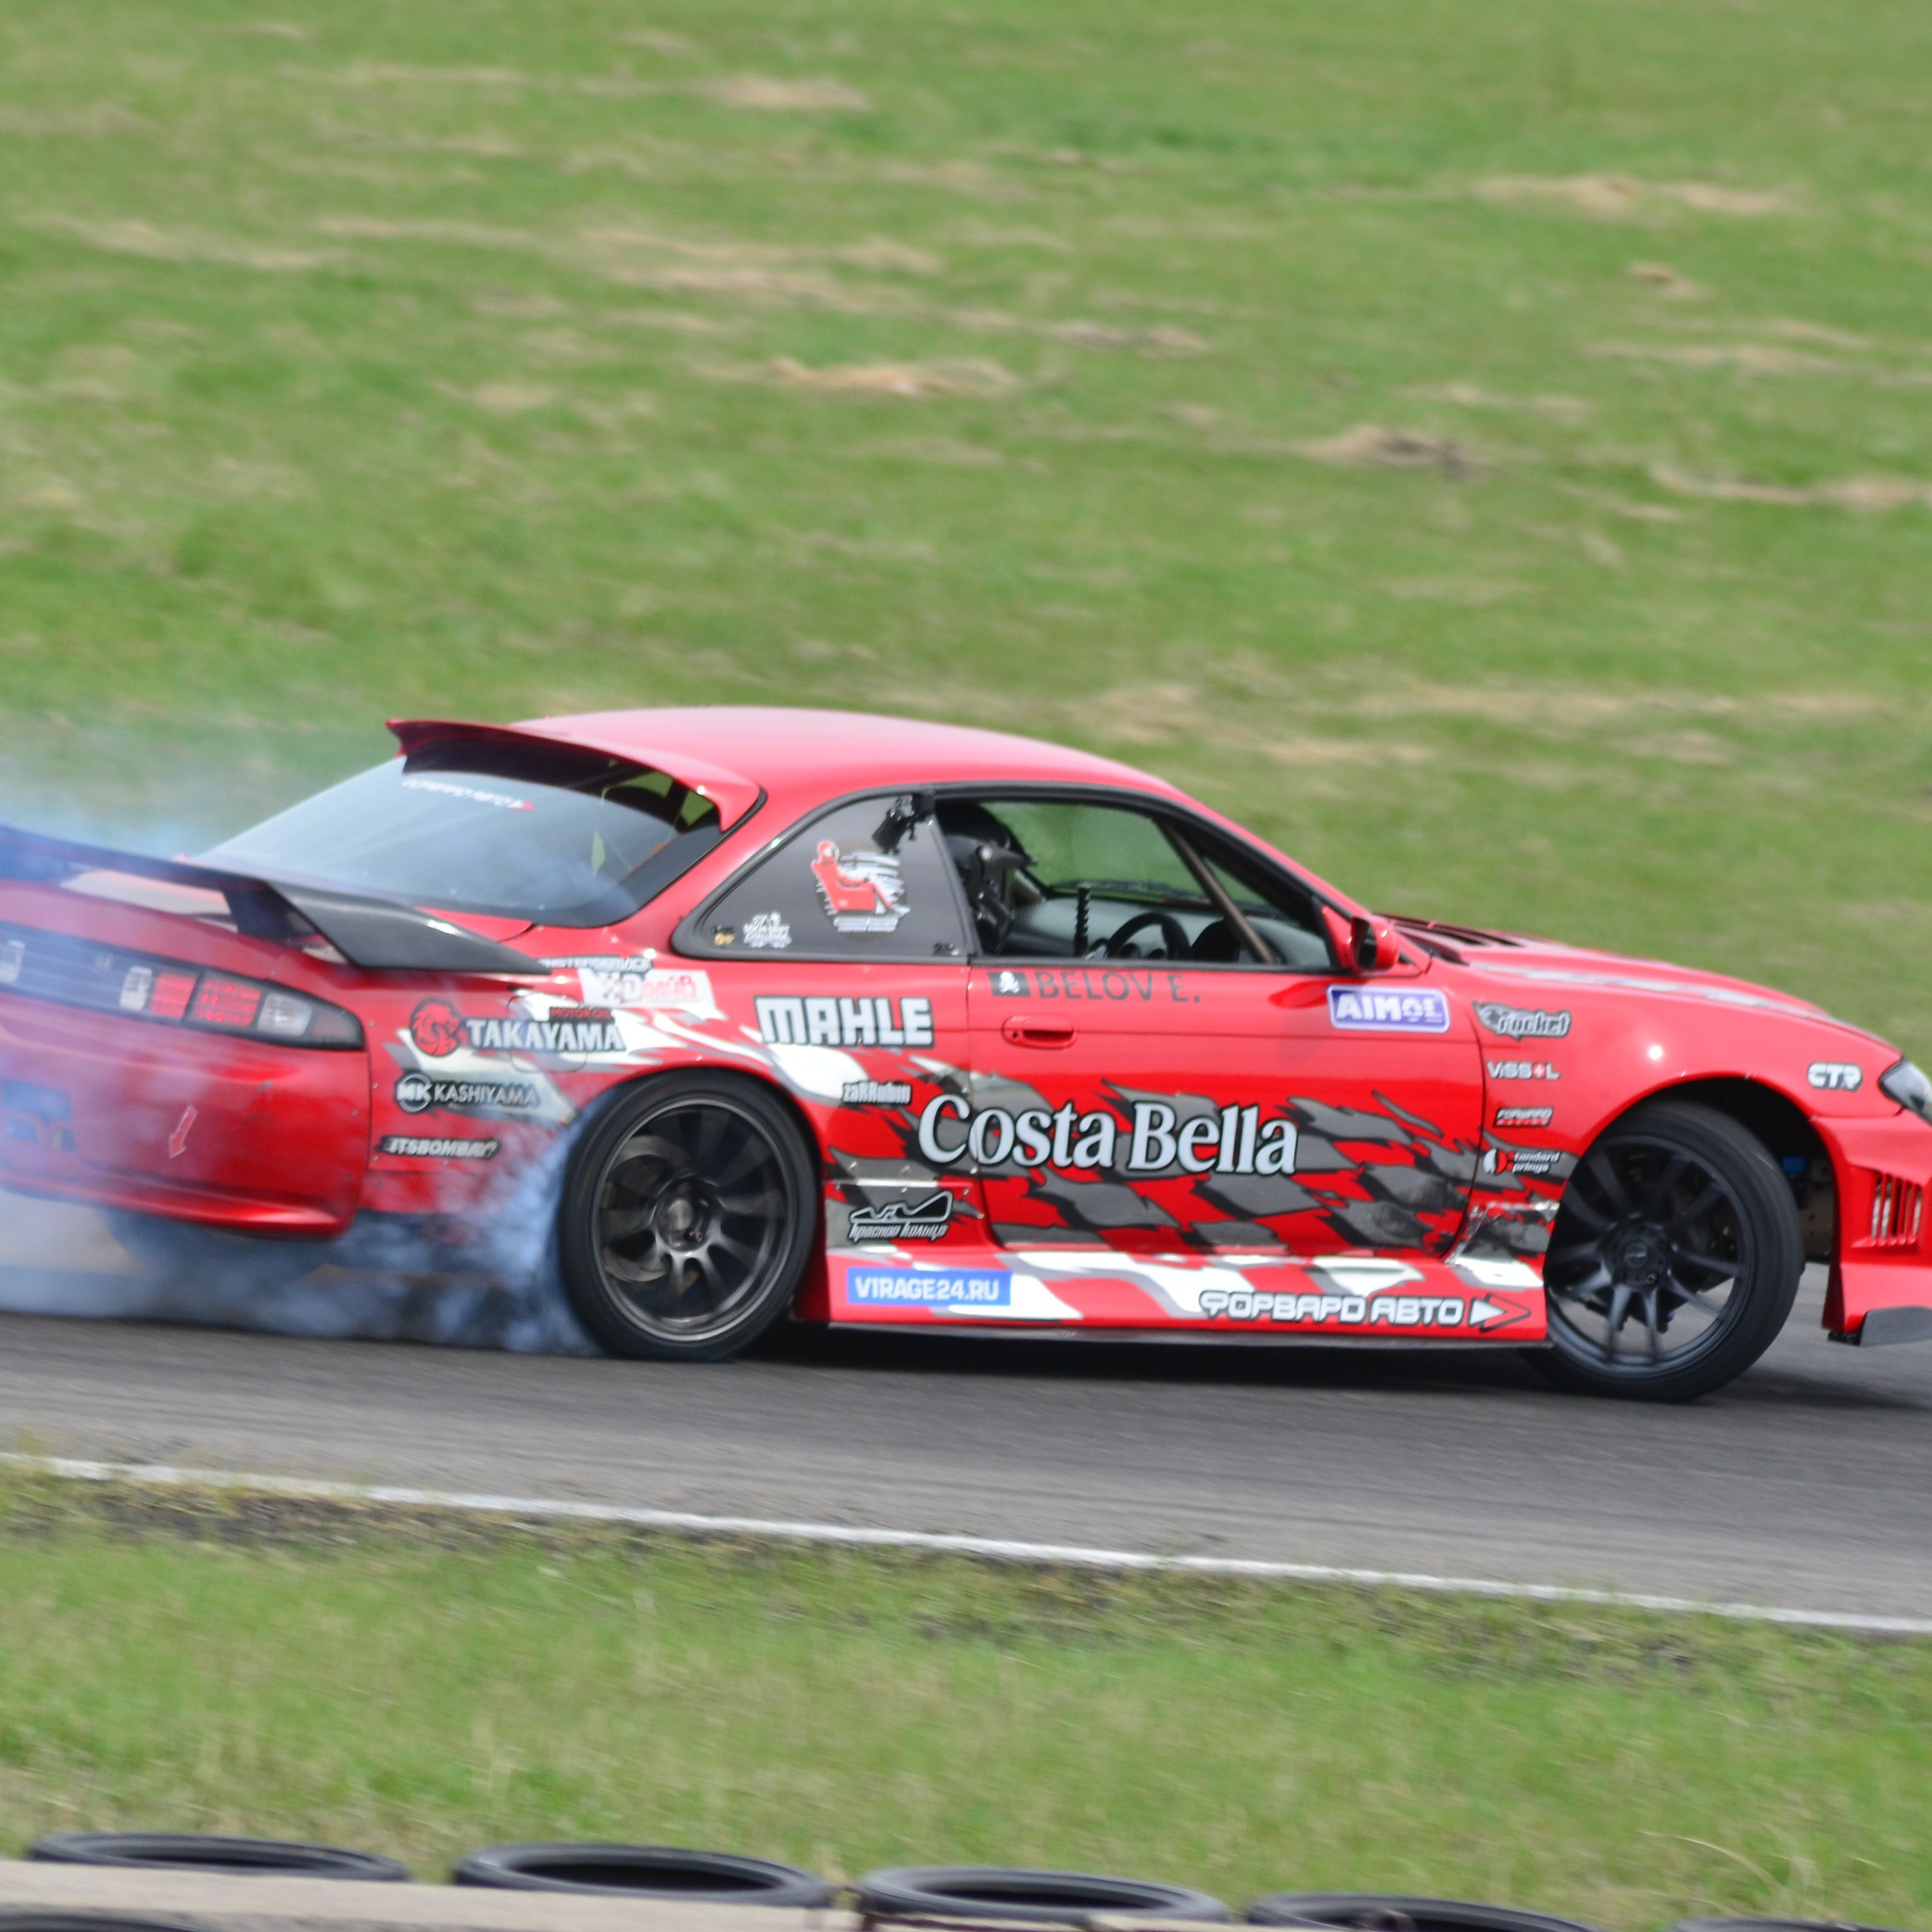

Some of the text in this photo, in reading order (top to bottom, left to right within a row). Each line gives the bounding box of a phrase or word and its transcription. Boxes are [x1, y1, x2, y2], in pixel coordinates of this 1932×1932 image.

[1033, 971, 1201, 1003] BELOV E.
[755, 995, 934, 1048] MAHLE
[1335, 992, 1443, 1023] AIMOL
[465, 1019, 626, 1051] TAKAYAMA
[1807, 1062, 1863, 1092] CTR
[433, 1081, 538, 1107] KASHIYAMA
[918, 1093, 1298, 1175] Costa Bella
[854, 1276, 1000, 1301] VIRAGE24.RU
[1370, 1295, 1465, 1327] АВТО
